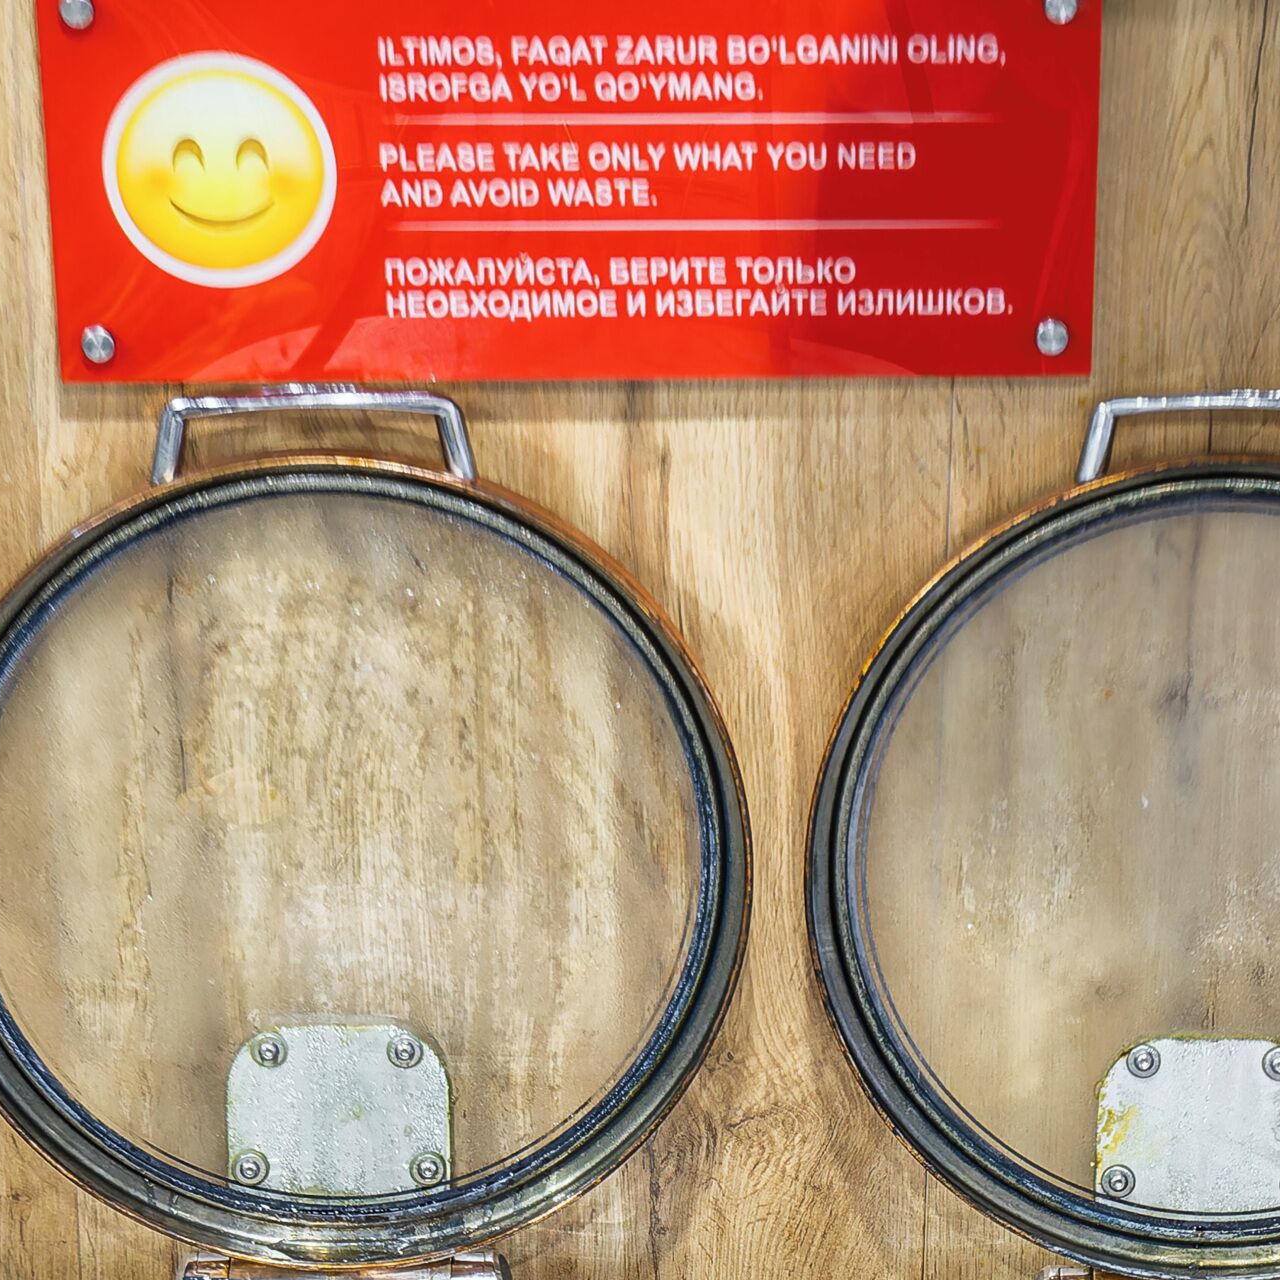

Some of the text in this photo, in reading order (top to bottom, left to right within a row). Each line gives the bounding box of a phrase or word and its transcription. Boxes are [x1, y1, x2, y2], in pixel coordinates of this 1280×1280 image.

[377, 33, 1007, 70] ILTIMOS, FAQAT ZARUR BO'LGANINI OLING,
[379, 70, 764, 103] ISROFGA YO'L QO'YMANG.
[379, 140, 917, 173] PLEASE TAKE ONLY WHAT YOU NEED
[380, 177, 658, 208] AND AVOID WASTE.
[384, 252, 857, 289] ПОЖАЛУЙСТА, БЕРИТЕ ТОЛЬКО
[385, 285, 1013, 323] НЕОБХОДИМОЕ И ИЗБЕГАЙТЕ ИЗЛИШКОВ.
